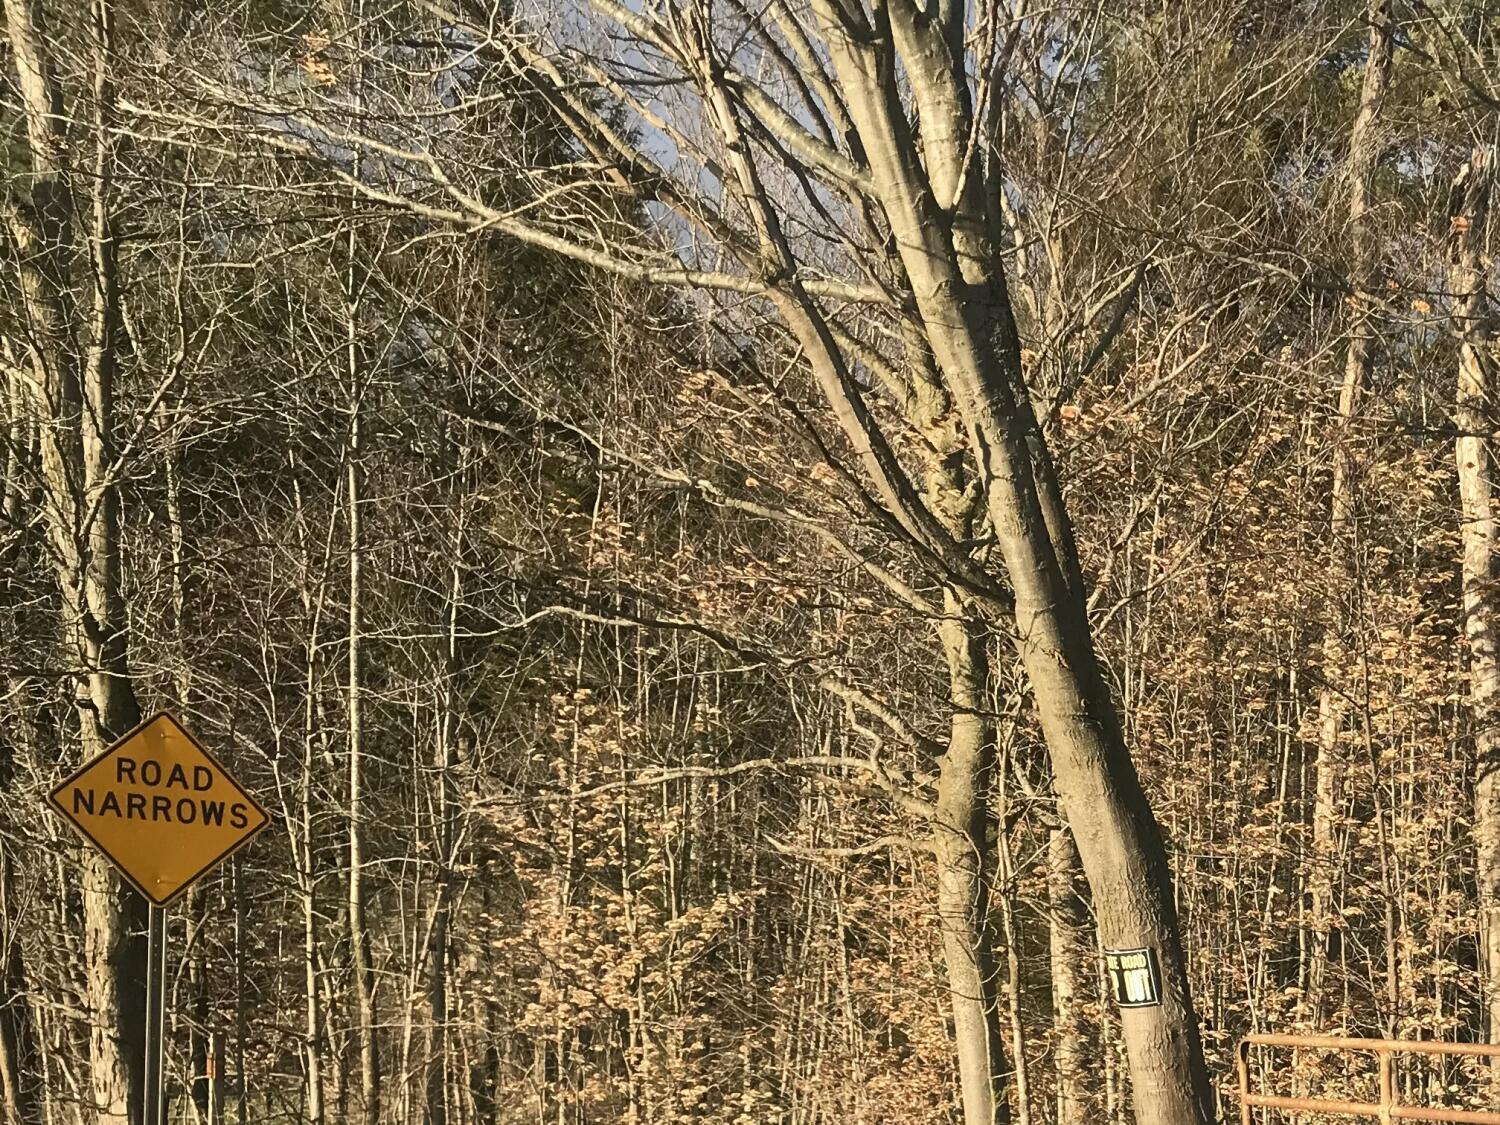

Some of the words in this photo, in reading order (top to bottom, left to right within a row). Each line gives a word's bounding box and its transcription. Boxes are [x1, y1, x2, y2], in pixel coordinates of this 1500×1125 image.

[116, 757, 213, 792] ROAD
[73, 788, 249, 830] NARROWS
[1120, 953, 1147, 970] ROAD
[1123, 969, 1152, 1003] OUT
